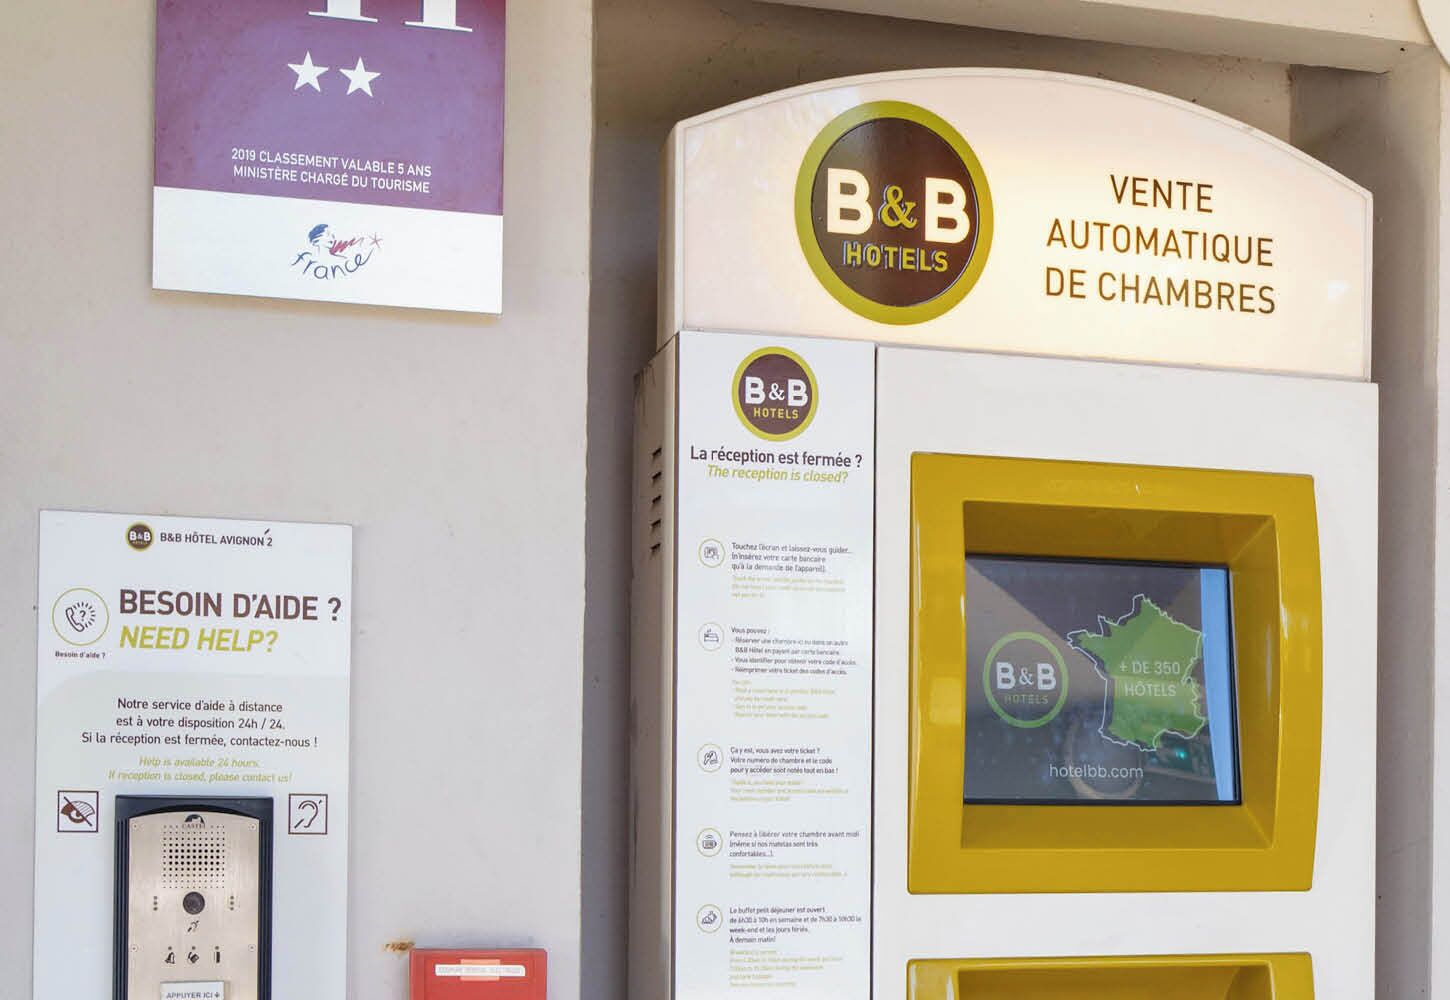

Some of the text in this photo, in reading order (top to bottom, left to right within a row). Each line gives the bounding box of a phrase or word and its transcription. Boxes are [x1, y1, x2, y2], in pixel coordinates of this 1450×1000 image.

[231, 148, 431, 177] 2019 CLASSEMENT VALABLE 5 ANS
[233, 164, 430, 193] MINISTÈRE CHARGÉ DU TOURISME
[1110, 174, 1213, 214] VENTE
[826, 167, 971, 244] B&B
[1046, 217, 1273, 267] AUTOMATIQUE
[844, 239, 948, 274] HOTELS
[1045, 267, 1276, 314] DE CHAMBRES
[745, 375, 808, 406] B&B
[753, 406, 799, 421] HOTELS
[691, 445, 862, 468] La réception est fermée ?
[707, 464, 848, 485] The reception is closed?
[129, 531, 151, 542] B&B
[160, 532, 182, 543] B&B
[185, 531, 217, 544] HÔTEL
[220, 536, 264, 546] AVIGNON
[732, 543, 758, 551] Touchez
[120, 589, 341, 621] BESOIN D'AIDE ?
[119, 625, 278, 652] NEED HELP?
[996, 662, 1056, 690] B&B
[1132, 662, 1151, 674] DE
[1154, 662, 1180, 674] 350
[1004, 695, 1048, 704] HOTELS
[1125, 682, 1176, 697] HÔTELS
[118, 698, 283, 712] Notre service d'aide à distance
[82, 732, 318, 747] Si la réception est fermée, contactez-nous !
[139, 757, 161, 767] Help
[164, 758, 171, 767] is
[174, 757, 214, 767] available
[217, 758, 229, 767] 24
[1050, 764, 1143, 778] hotelbb.com
[167, 991, 202, 1000] APPUYER
